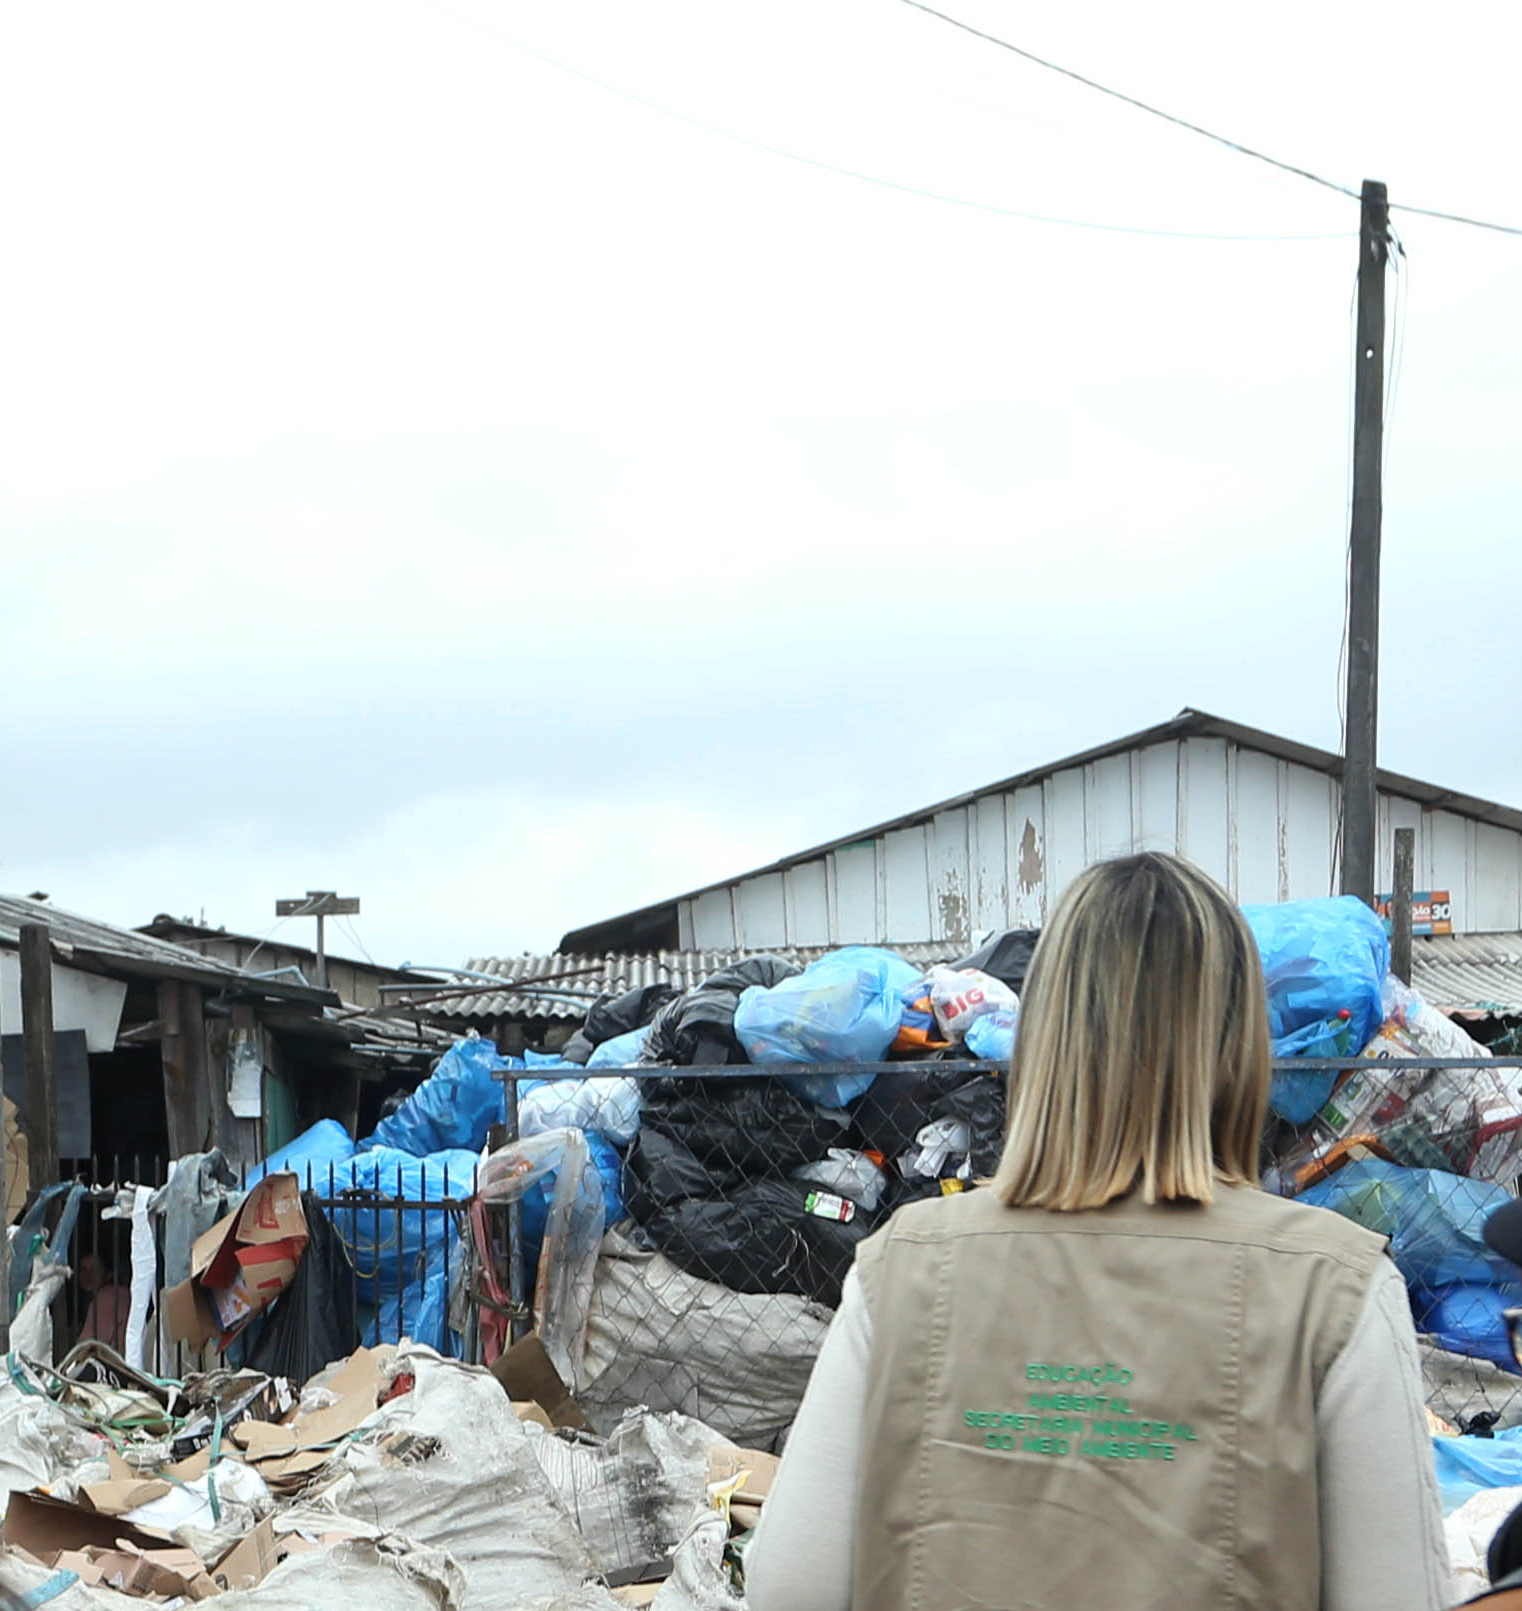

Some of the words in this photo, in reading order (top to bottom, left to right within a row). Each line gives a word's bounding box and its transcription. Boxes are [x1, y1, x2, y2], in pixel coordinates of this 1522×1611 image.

[1431, 903, 1451, 920] 30
[1026, 1362, 1133, 1387] EDUCAÇÃO
[1028, 1394, 1134, 1414] AMBIENTAL
[984, 1432, 1014, 1450] DO
[1024, 1436, 1069, 1455] MEIO
[1080, 1441, 1175, 1460] AMBIENTE
